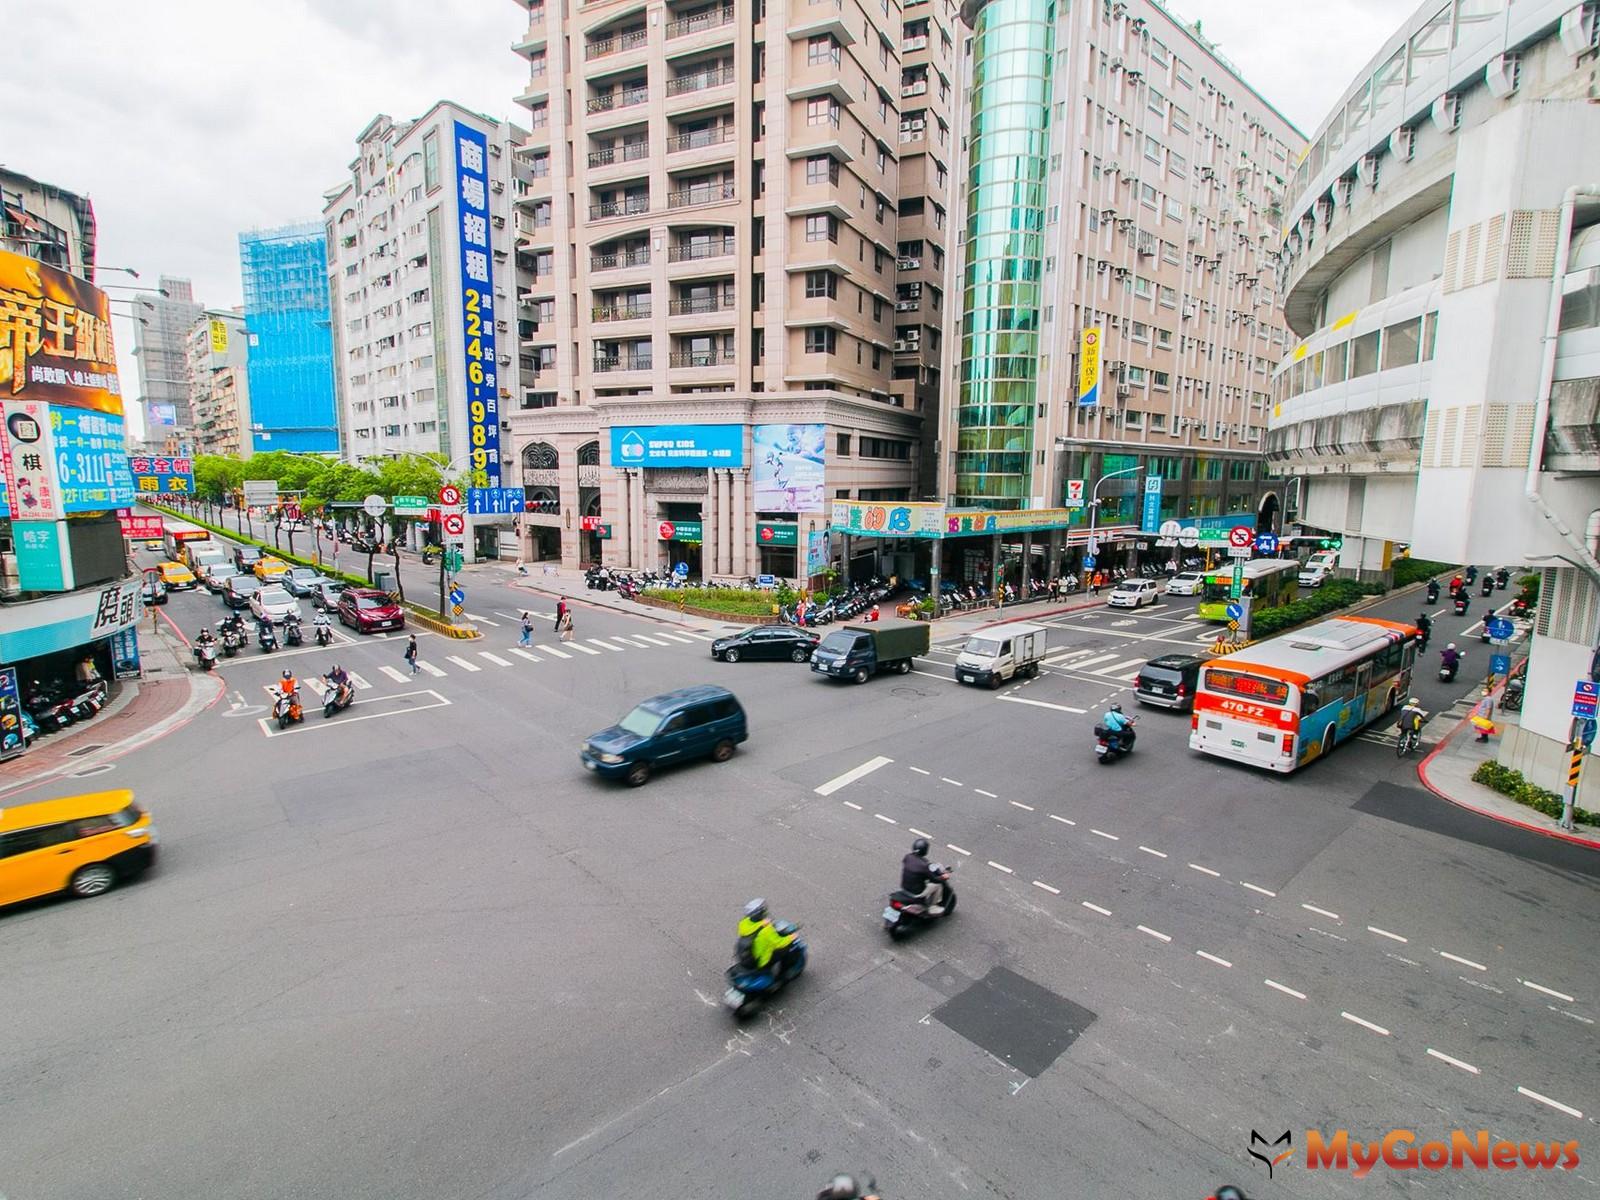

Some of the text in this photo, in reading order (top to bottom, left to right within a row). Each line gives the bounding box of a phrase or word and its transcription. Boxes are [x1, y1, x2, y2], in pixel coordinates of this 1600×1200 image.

[460, 138, 489, 283] 商場招租
[131, 458, 192, 475] 安全帽
[137, 476, 188, 492] 雨衣
[1220, 700, 1265, 717] 470-FZ
